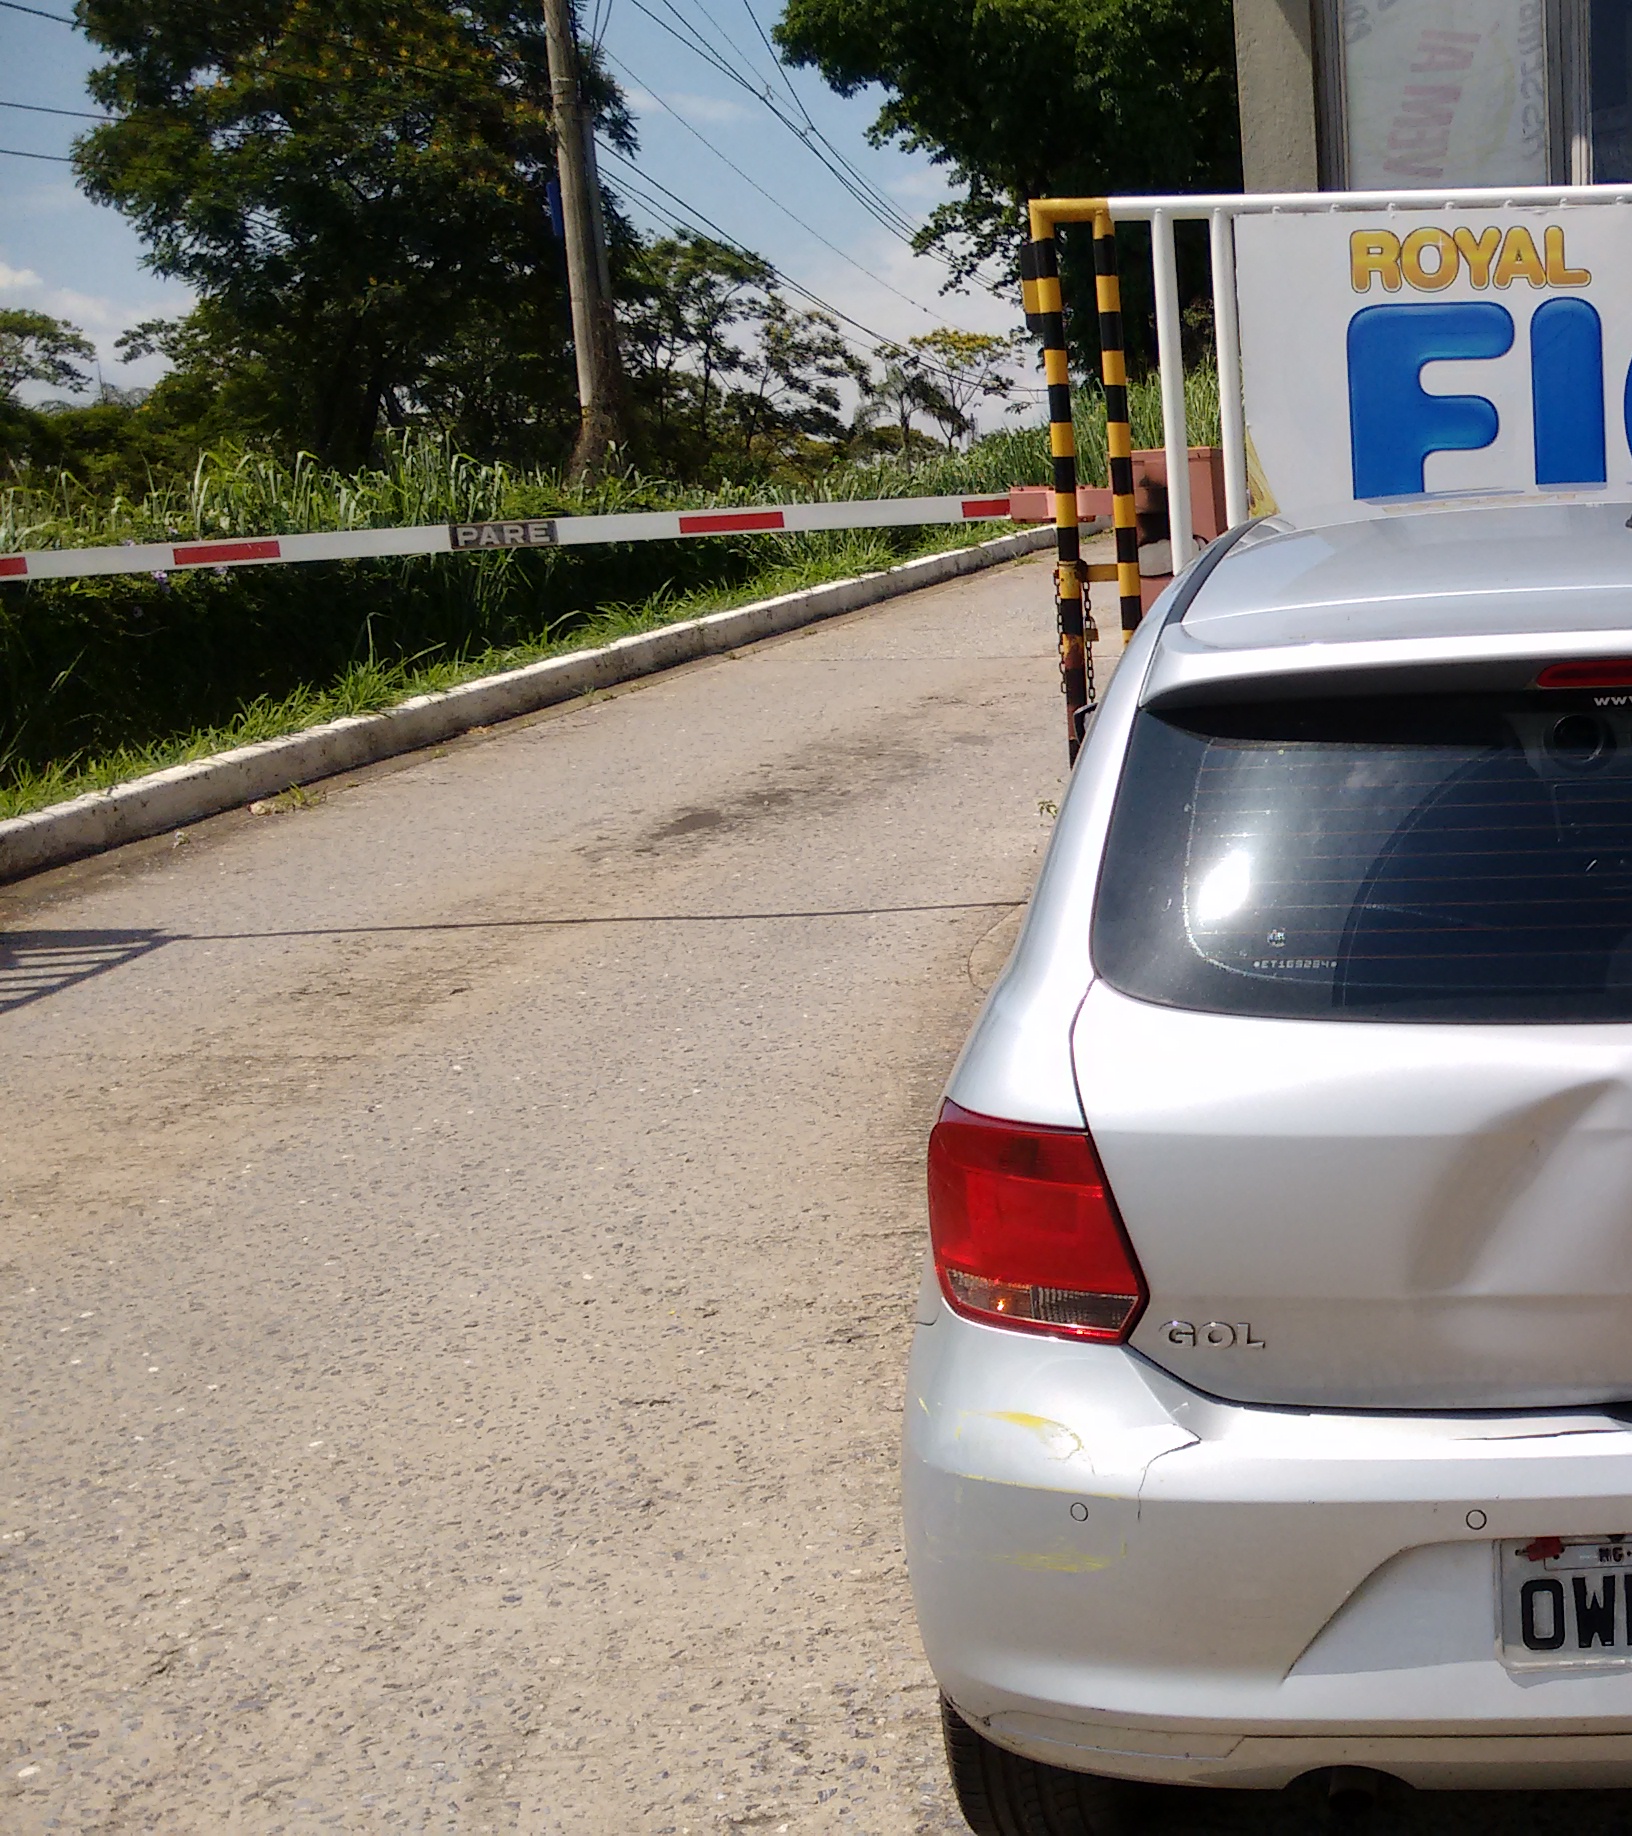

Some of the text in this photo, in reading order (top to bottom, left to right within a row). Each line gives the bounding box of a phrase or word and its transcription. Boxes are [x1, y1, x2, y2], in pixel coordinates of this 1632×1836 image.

[1349, 226, 1592, 293] ROYAL
[457, 523, 551, 546] PARE
[1159, 1321, 1265, 1349] GOL
